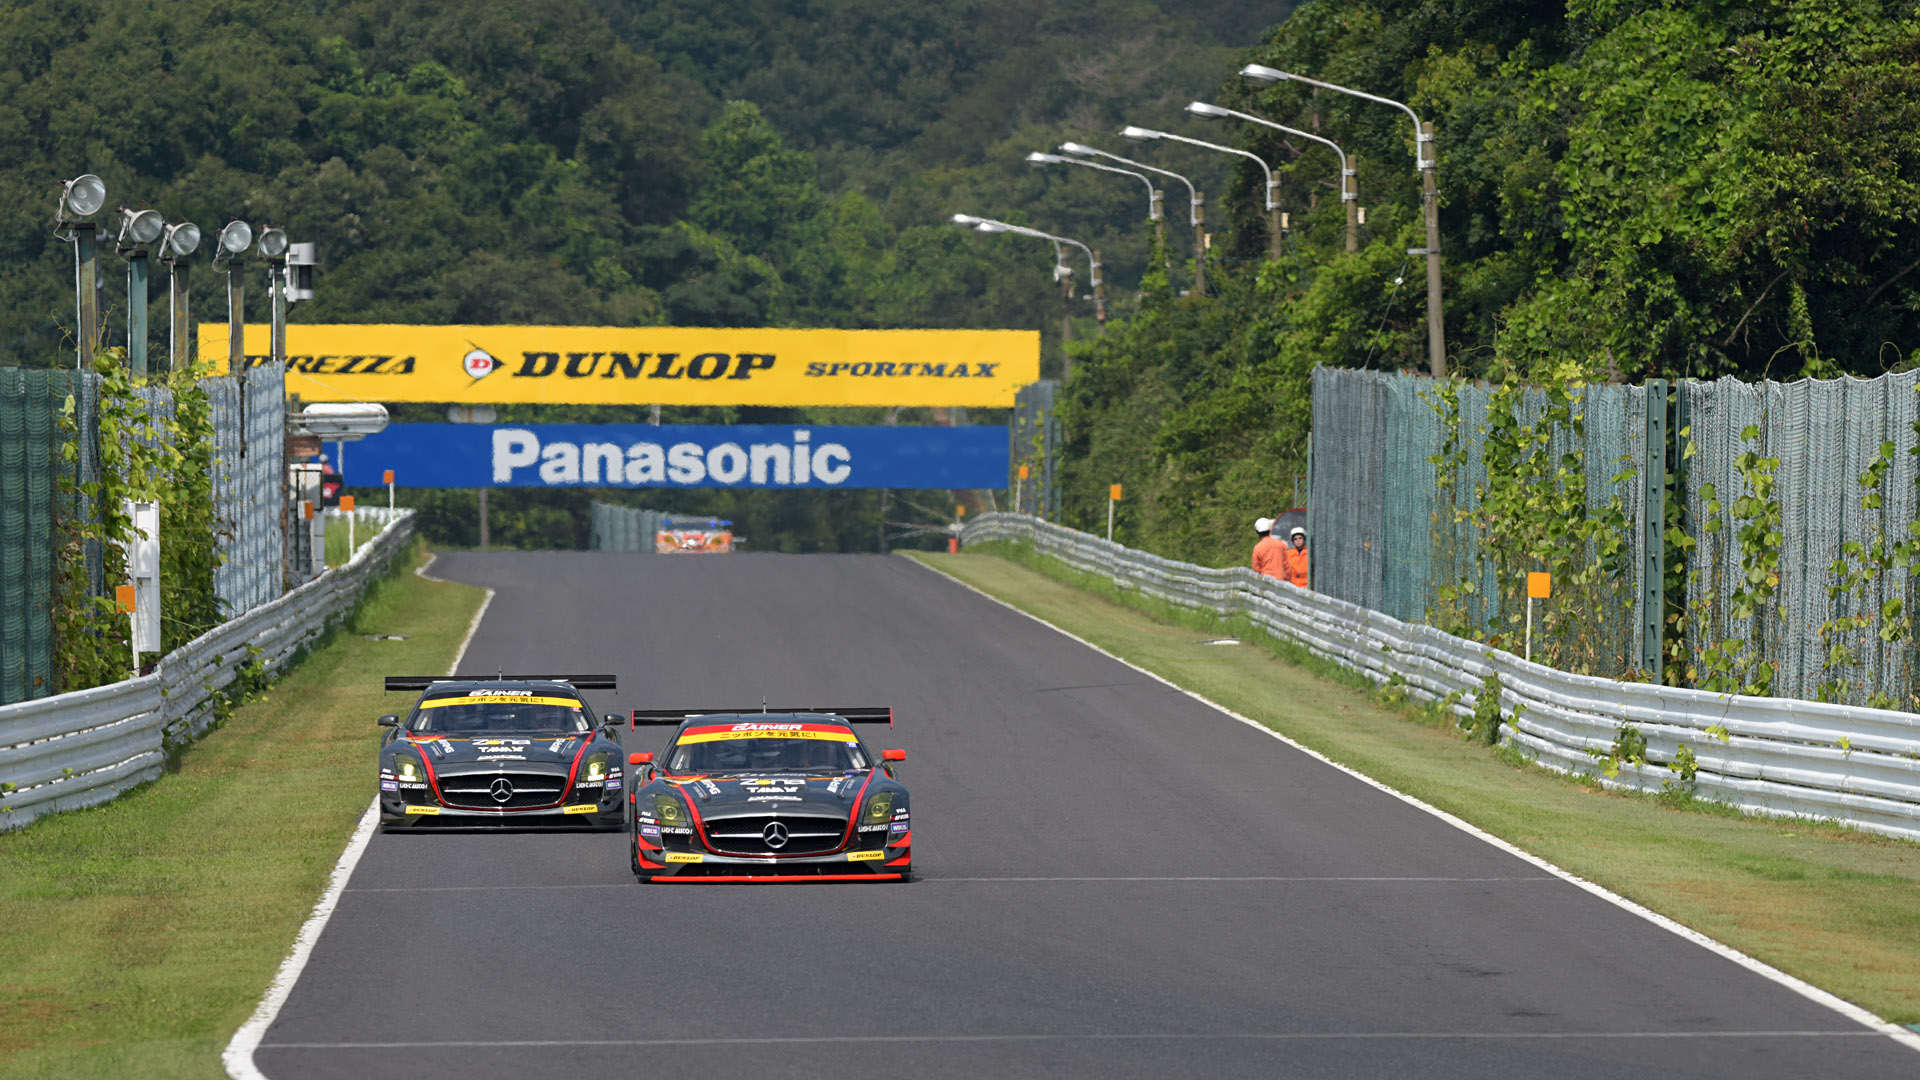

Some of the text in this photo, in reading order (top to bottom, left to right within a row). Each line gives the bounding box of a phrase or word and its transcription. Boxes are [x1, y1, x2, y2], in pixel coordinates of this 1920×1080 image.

[244, 355, 416, 374] DREZZA
[513, 352, 776, 380] DUNLOP
[805, 361, 999, 378] SPORTMAX
[492, 430, 851, 485] Panasonic
[732, 723, 802, 731] GAINER
